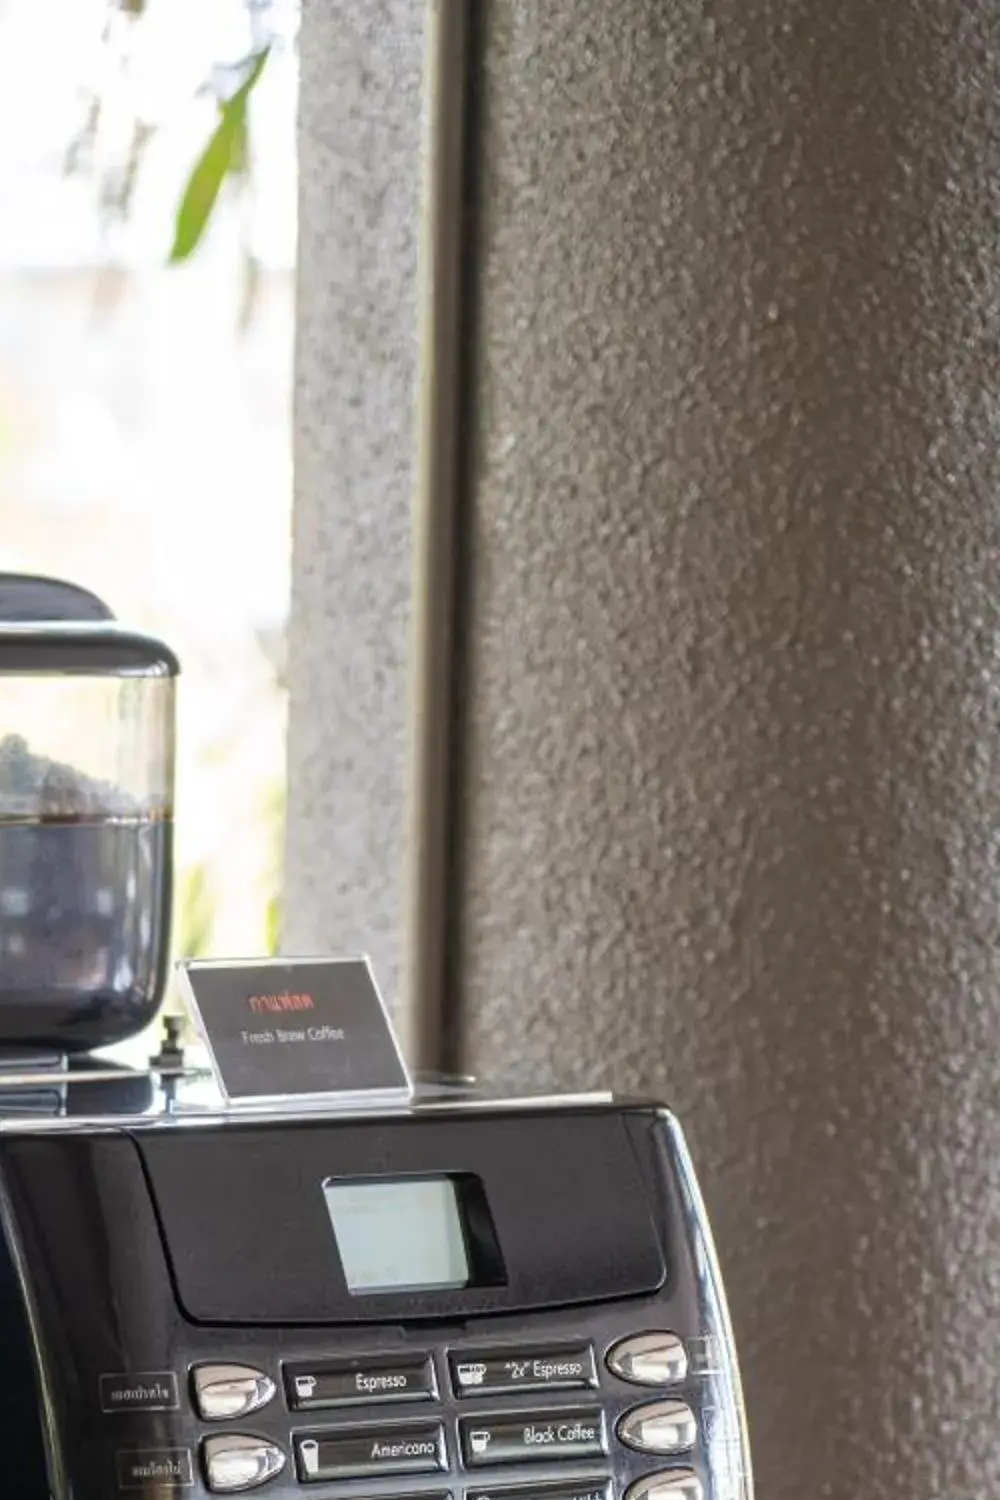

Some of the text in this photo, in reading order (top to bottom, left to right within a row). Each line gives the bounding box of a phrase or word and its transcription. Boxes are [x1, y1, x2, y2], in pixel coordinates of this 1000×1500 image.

[307, 1024, 345, 1041] Coffee
[533, 1360, 582, 1380] Espresso
[355, 1373, 407, 1392] Espresso
[523, 1423, 596, 1445] Black Coffee
[371, 1442, 435, 1459] Americano
